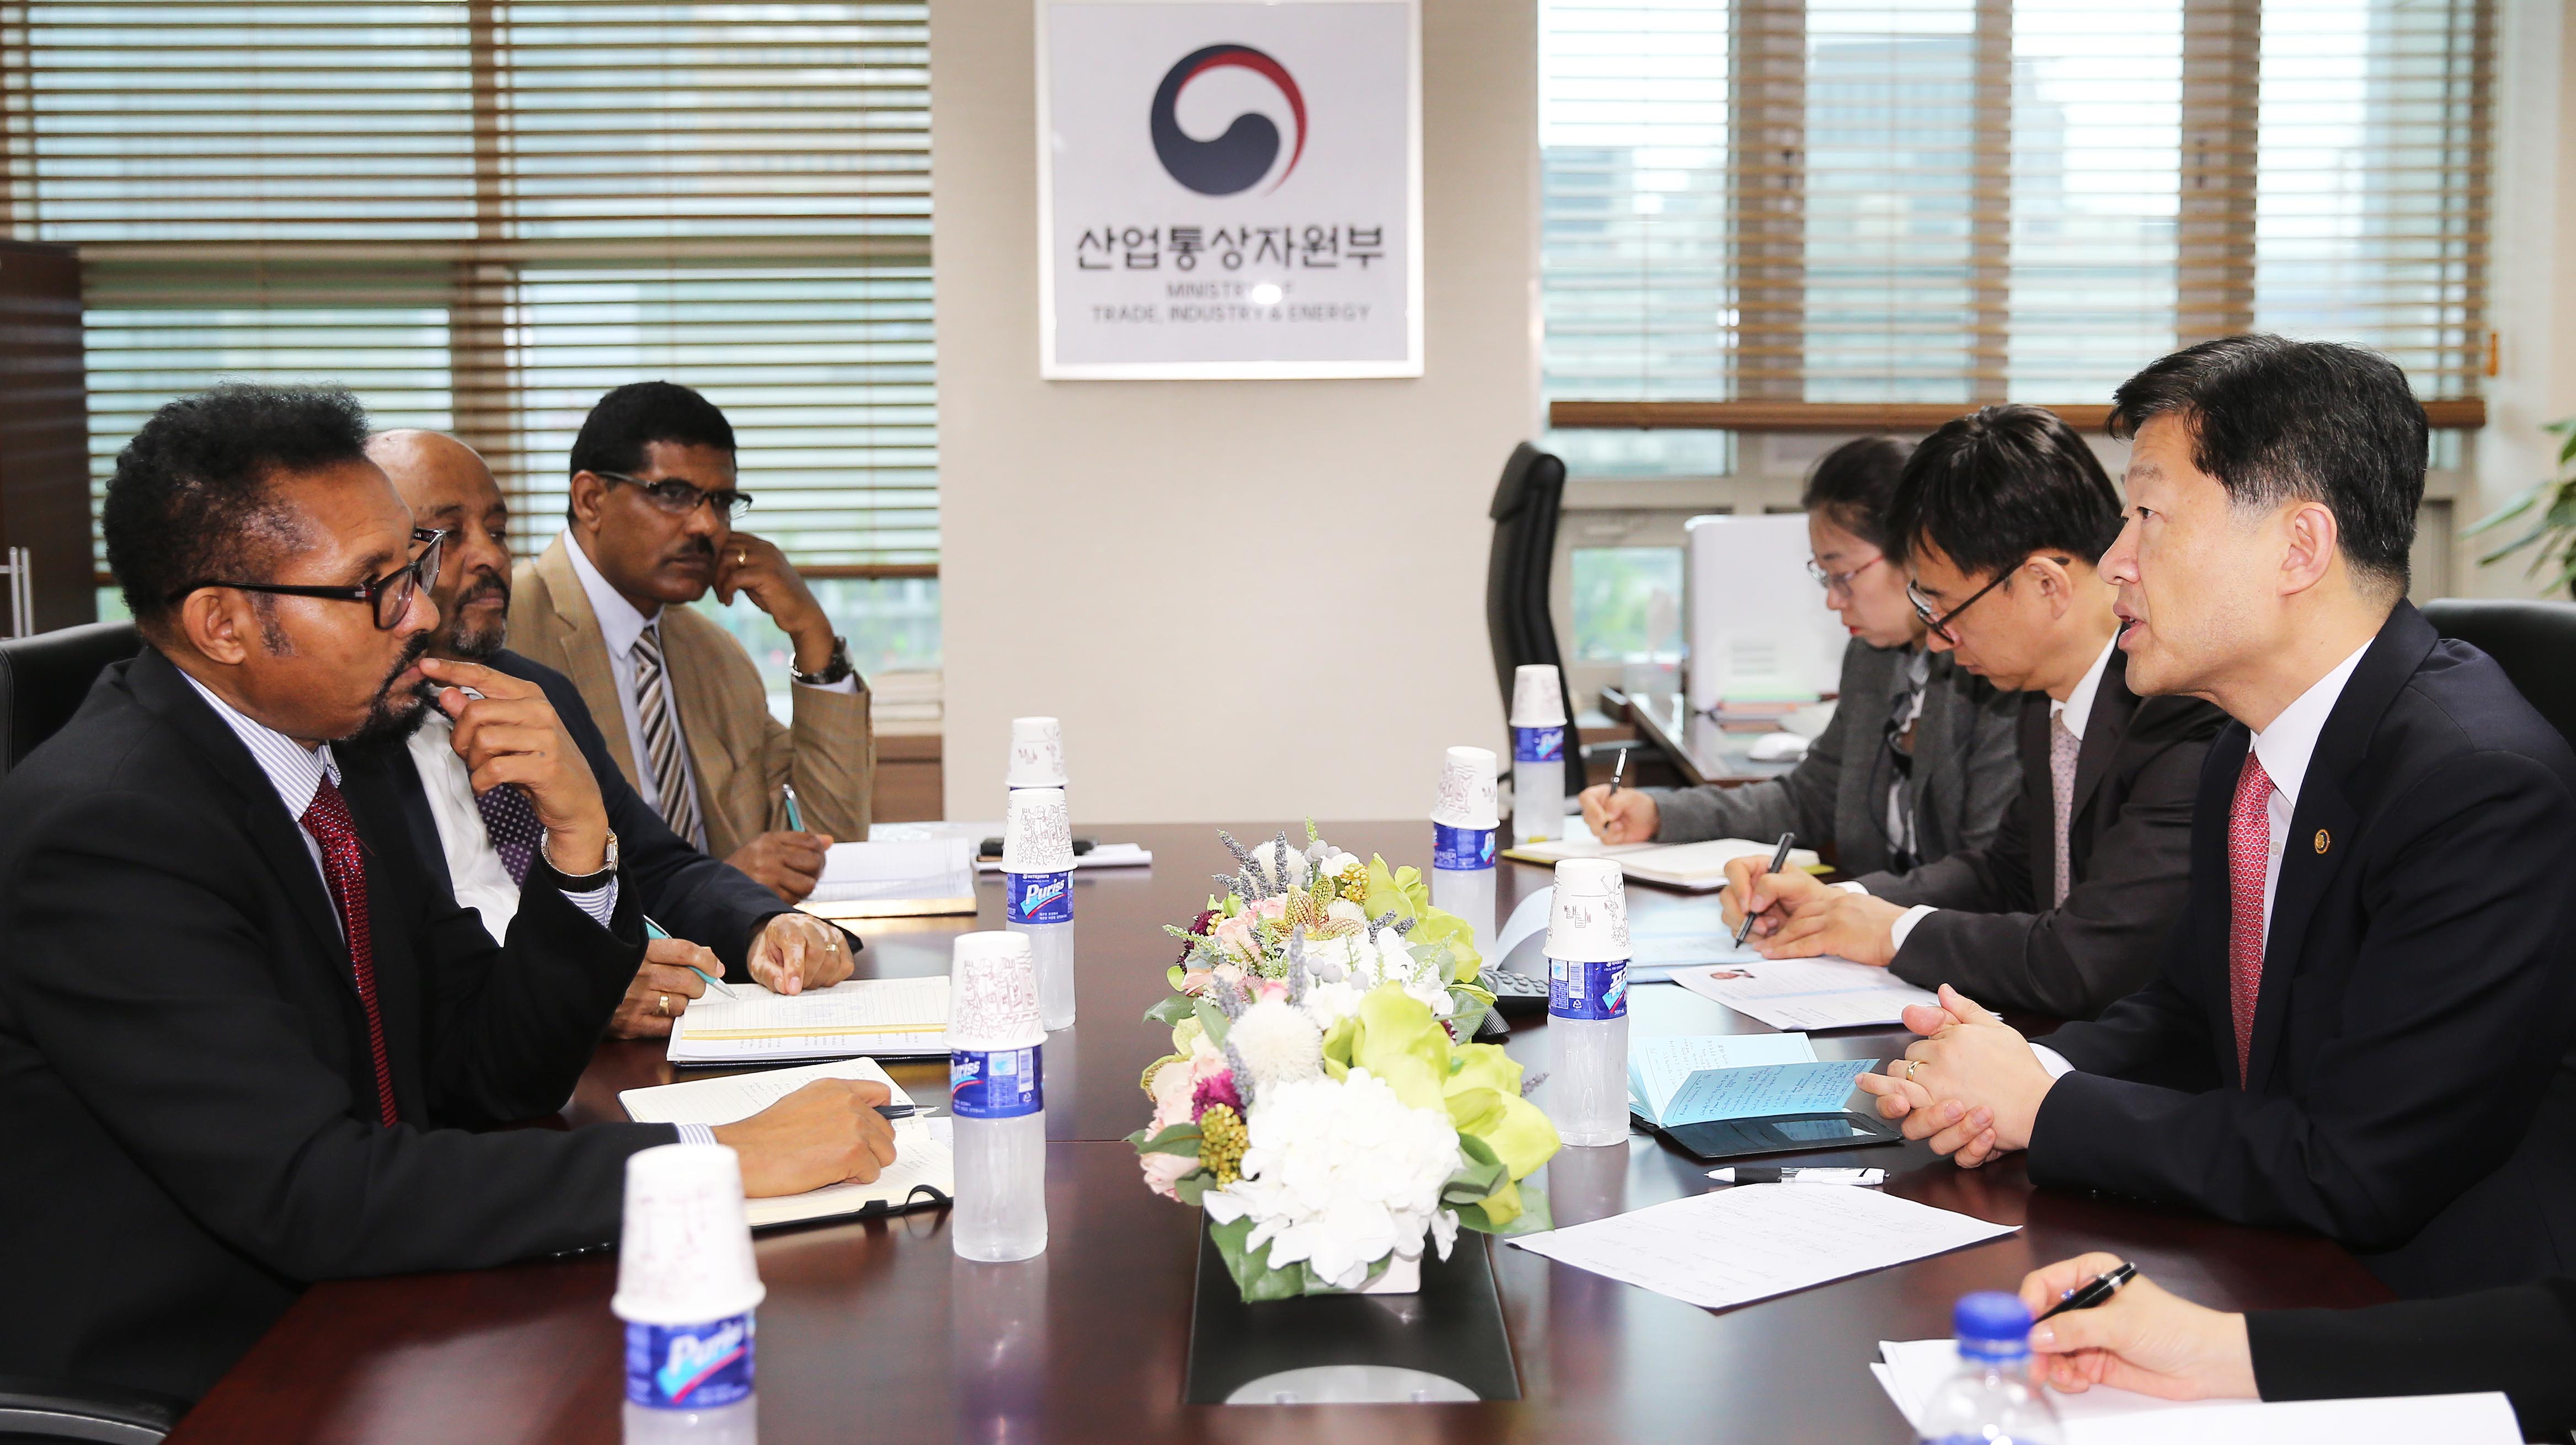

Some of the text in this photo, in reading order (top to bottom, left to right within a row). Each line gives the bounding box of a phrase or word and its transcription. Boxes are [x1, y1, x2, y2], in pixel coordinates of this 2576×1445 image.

[1076, 224, 1385, 271] 산업통상자원부
[1166, 281, 1254, 299] MINISTR
[1092, 303, 1372, 324] TRADE, INDUSTRY & ENERGY
[1025, 878, 1065, 906] Puriss
